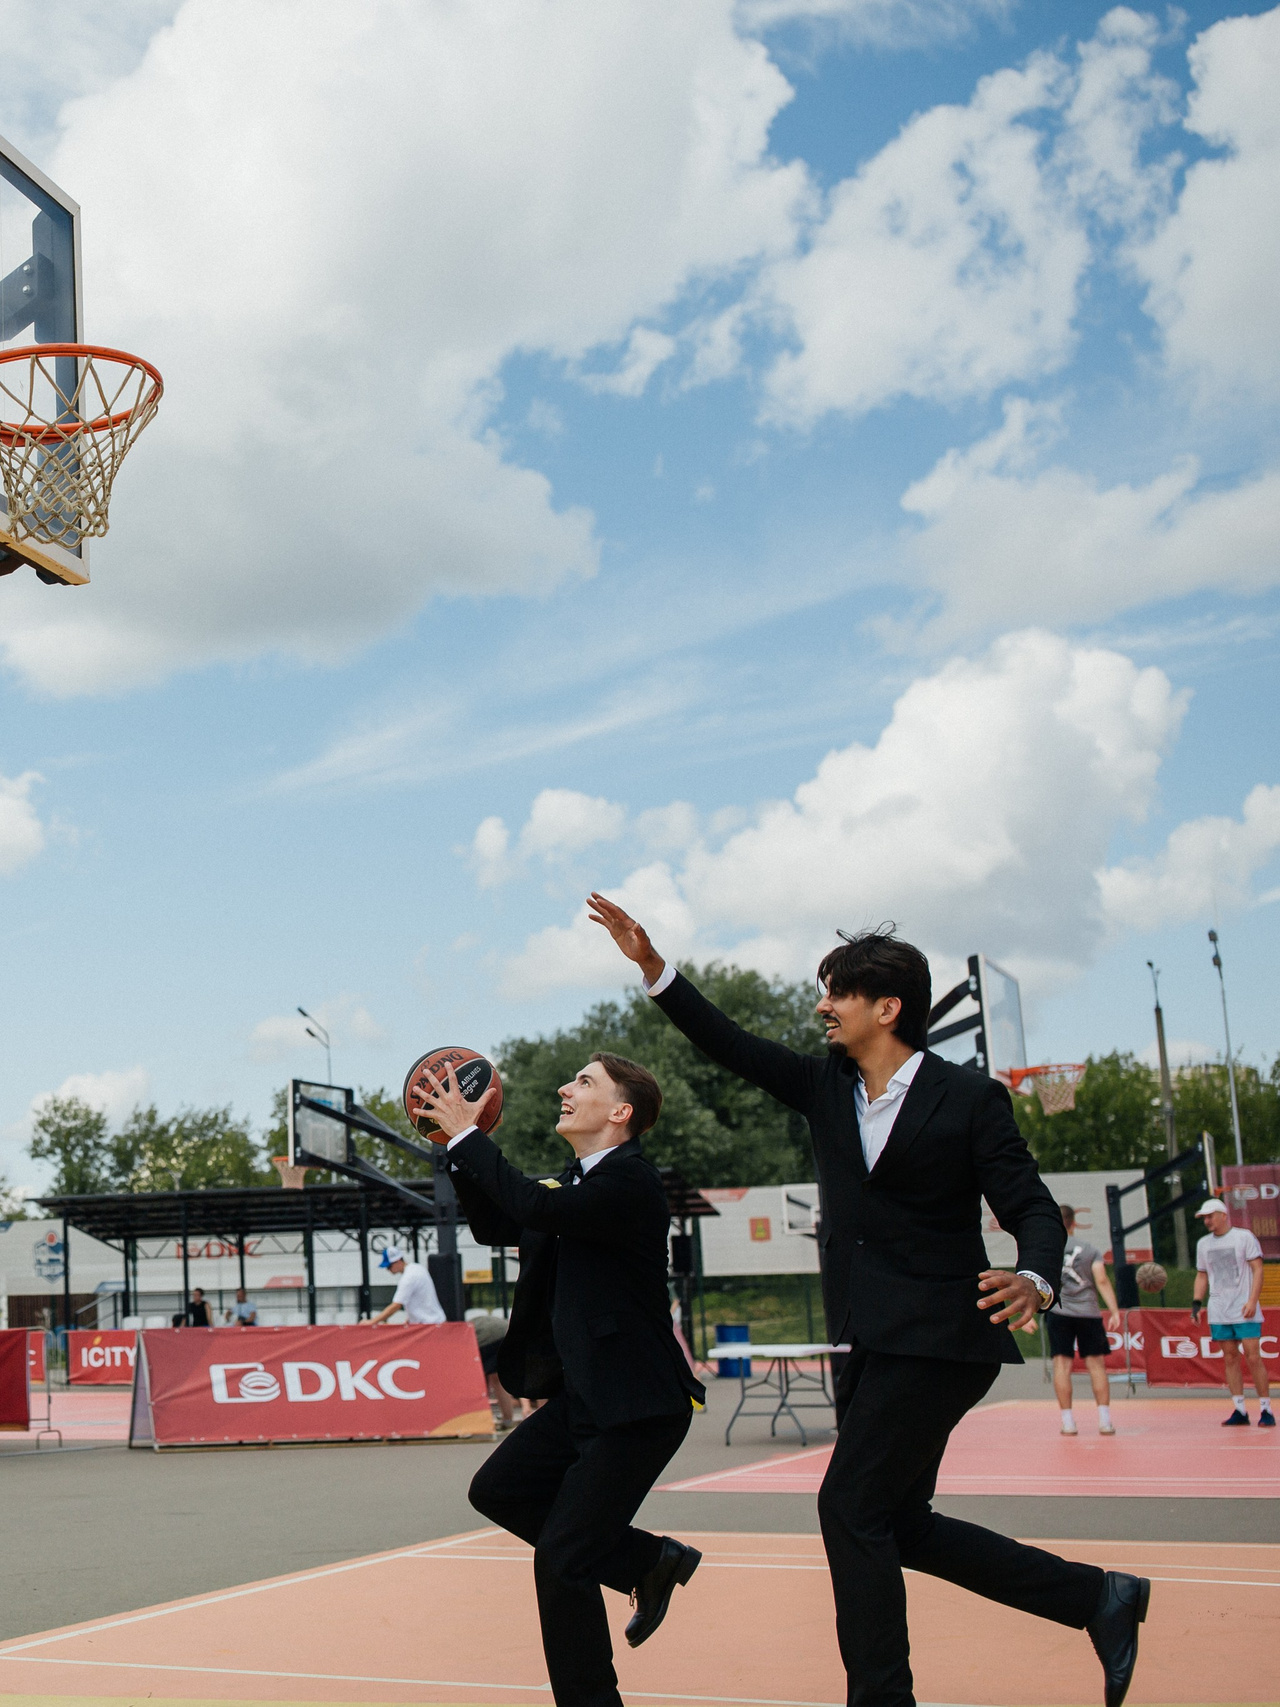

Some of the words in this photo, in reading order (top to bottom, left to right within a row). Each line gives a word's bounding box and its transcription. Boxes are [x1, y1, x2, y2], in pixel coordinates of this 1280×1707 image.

[461, 1065, 482, 1087] AIRLINES
[81, 1346, 138, 1368] ICITY
[282, 1358, 426, 1402] DKC
